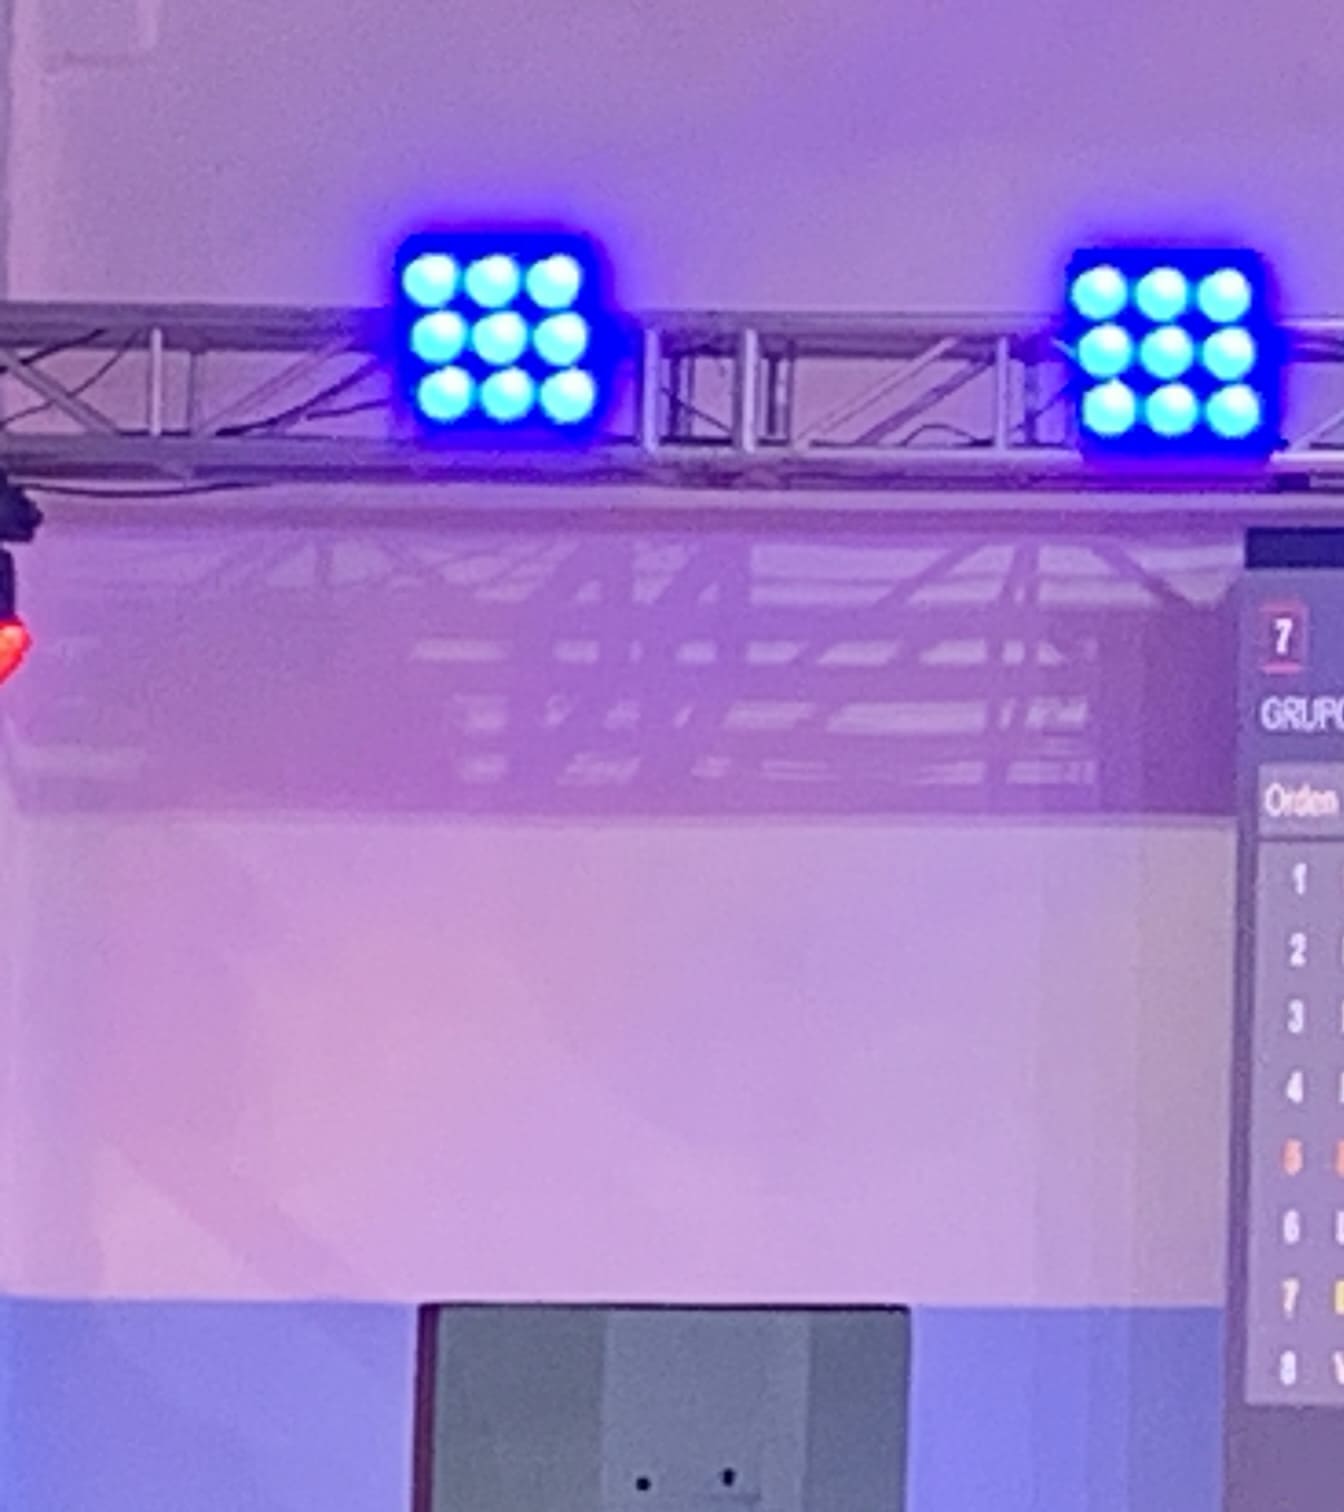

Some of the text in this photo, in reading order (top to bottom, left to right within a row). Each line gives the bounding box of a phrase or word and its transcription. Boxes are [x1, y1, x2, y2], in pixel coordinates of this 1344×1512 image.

[1275, 618, 1293, 655] 7
[1265, 784, 1340, 817] Orden
[1293, 863, 1306, 894] 1
[1290, 935, 1306, 966] 2
[1288, 1002, 1304, 1033] 3
[1287, 1072, 1303, 1102] 4
[1284, 1212, 1300, 1243] 6
[1282, 1281, 1300, 1312] 7
